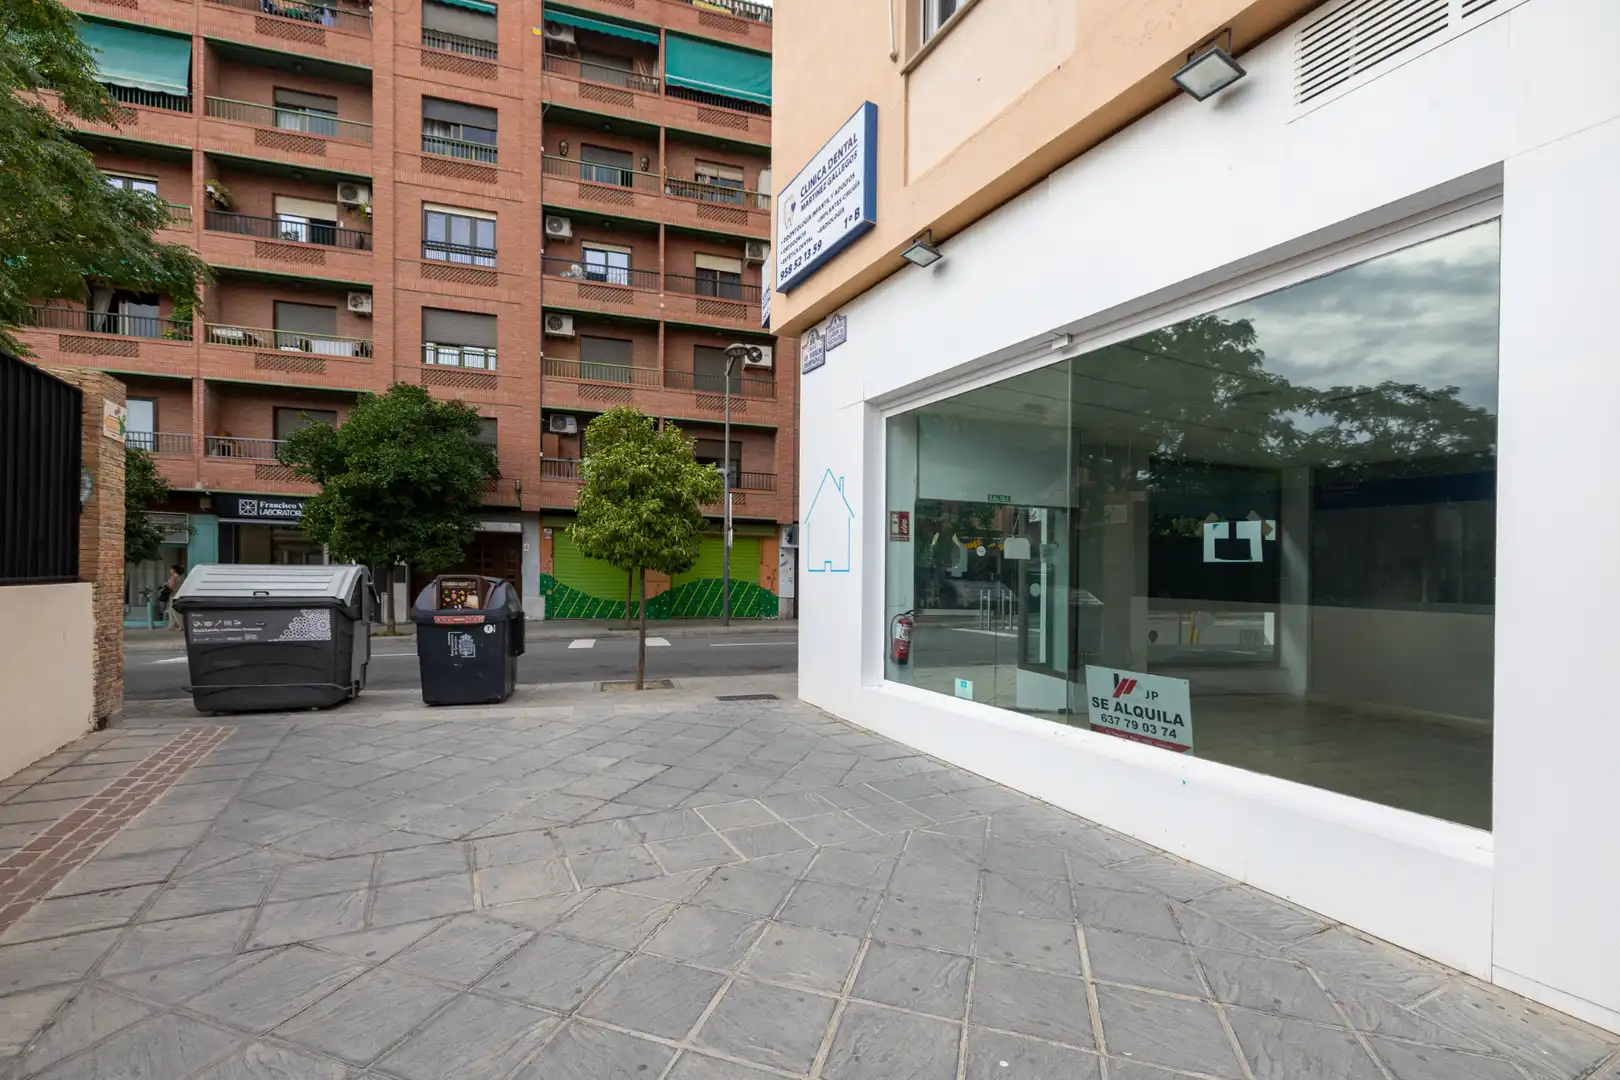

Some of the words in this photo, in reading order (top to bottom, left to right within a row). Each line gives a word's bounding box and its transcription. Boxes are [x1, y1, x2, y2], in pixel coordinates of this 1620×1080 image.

[800, 165, 826, 198] CLINICA
[828, 133, 857, 170] DENTAL
[828, 150, 857, 186] GALLEGOS
[834, 172, 855, 196] ADULTOS
[780, 264, 792, 281] 958
[793, 255, 802, 271] 52
[803, 247, 811, 262] 13
[812, 239, 822, 254] 59
[259, 501, 297, 509] Francisco
[1145, 690, 1159, 700] JP
[1092, 696, 1109, 710] SE
[1114, 702, 1185, 727] ALQUILA
[1101, 713, 1120, 726] 637
[1124, 718, 1139, 730] 79
[1142, 723, 1157, 735] 03
[1161, 727, 1177, 739] 74
